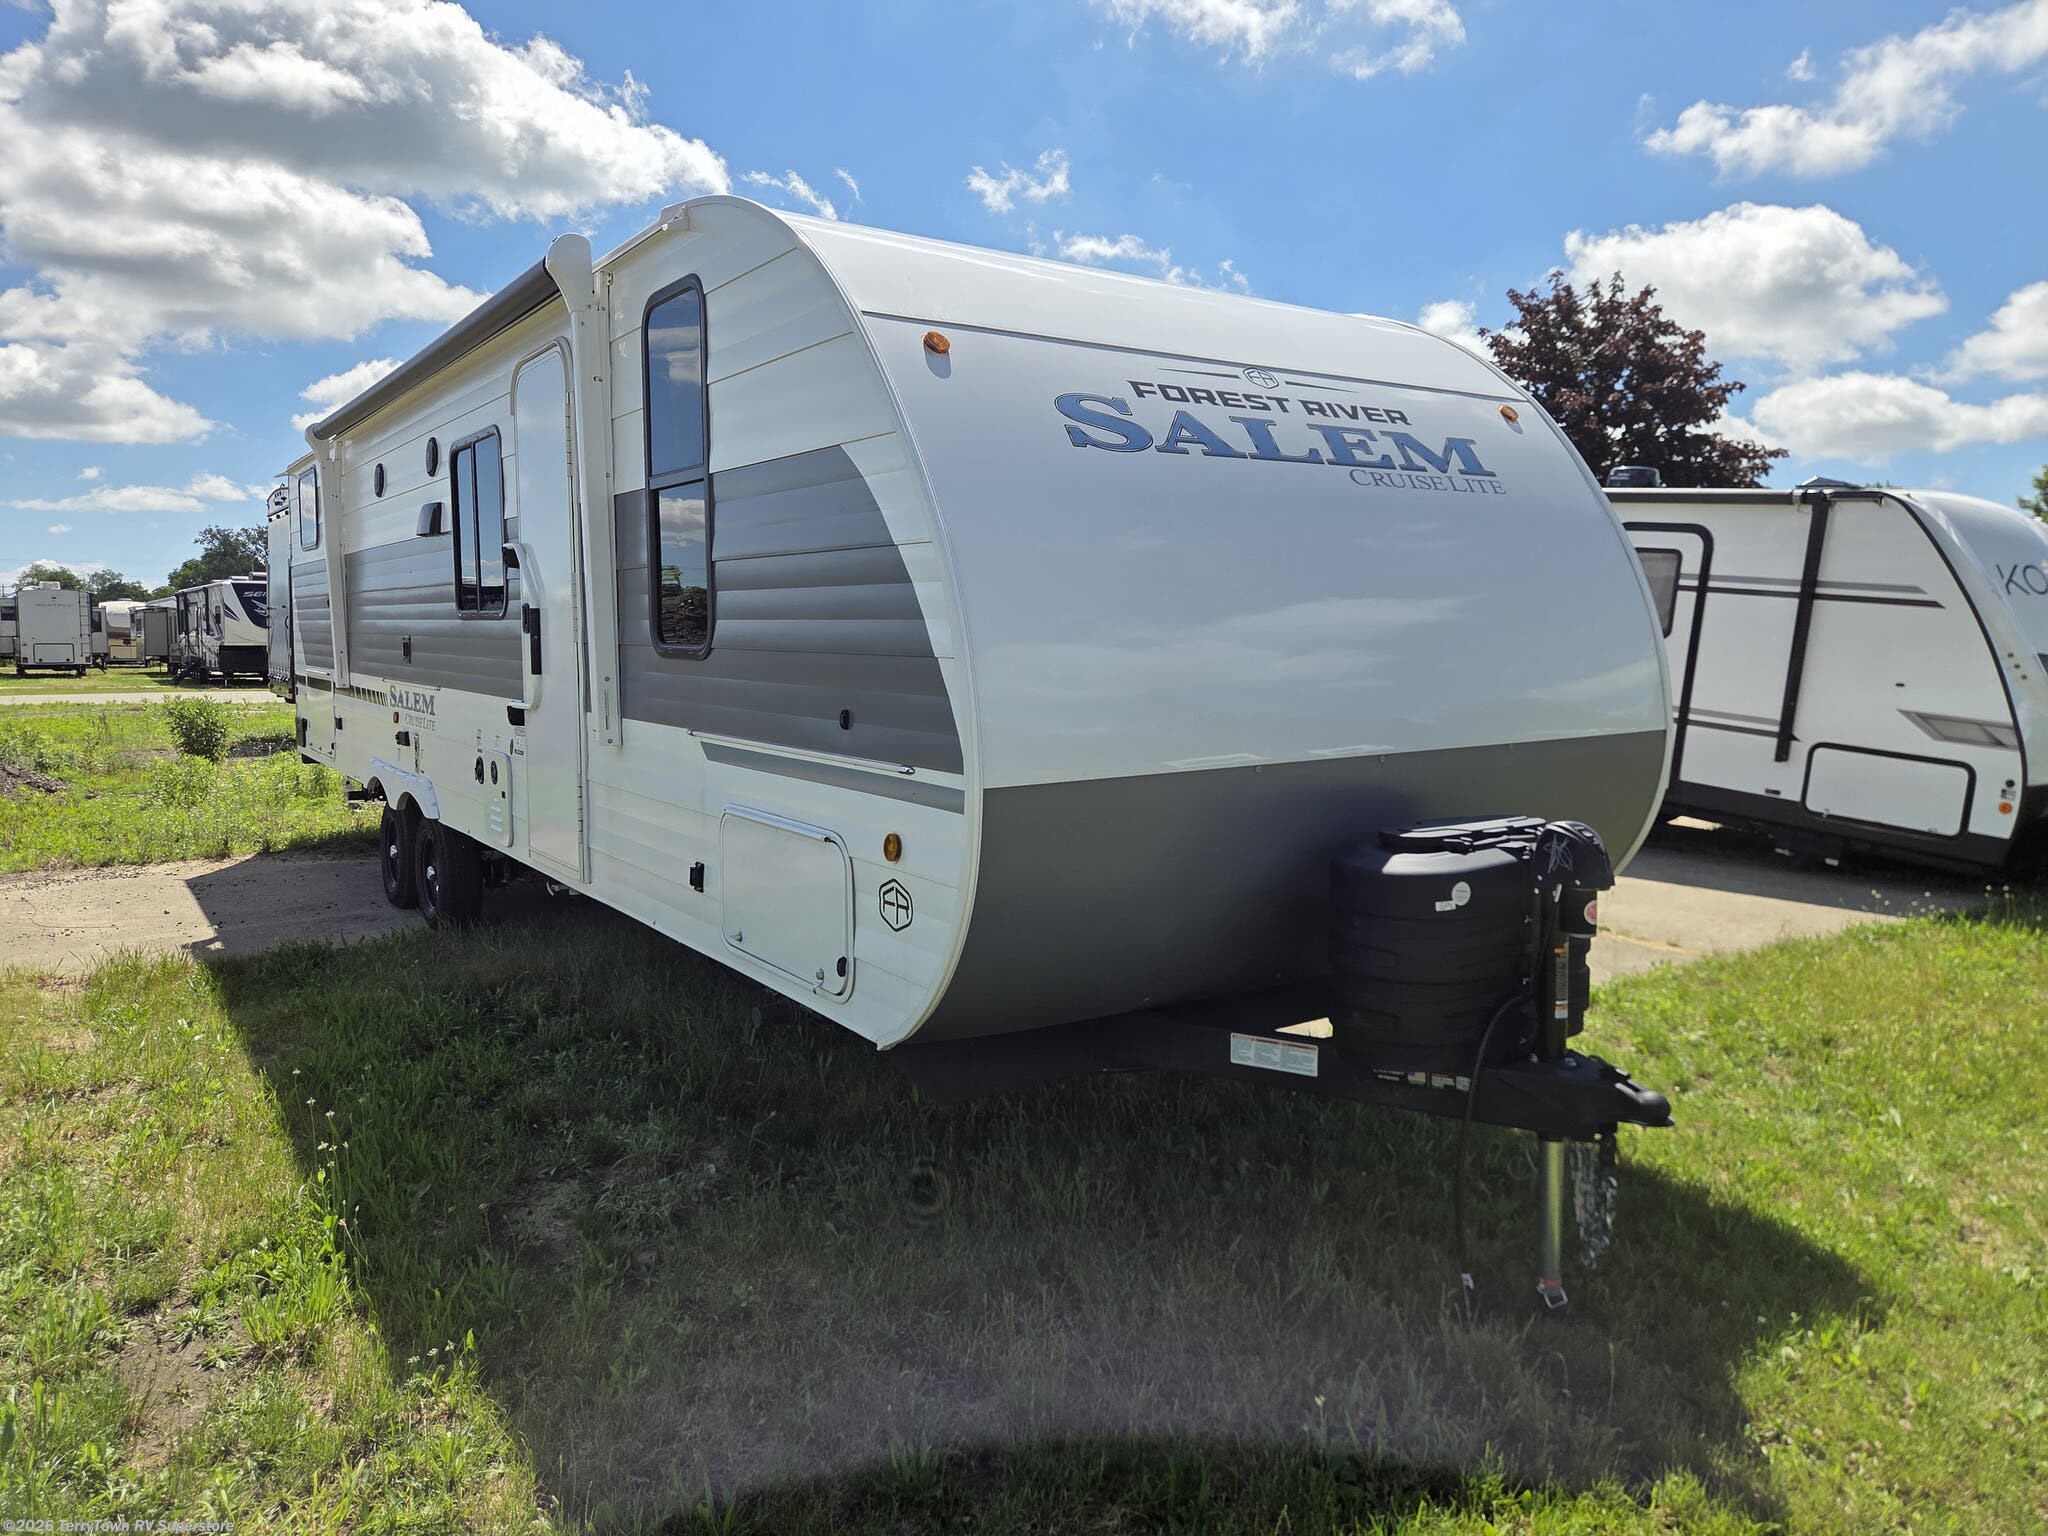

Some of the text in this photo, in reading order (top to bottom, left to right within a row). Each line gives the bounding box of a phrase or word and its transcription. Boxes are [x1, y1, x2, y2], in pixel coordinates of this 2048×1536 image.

[1127, 380, 1412, 426] FOREST RIVER
[1054, 392, 1497, 478] SALEM
[389, 685, 435, 715] SALEM
